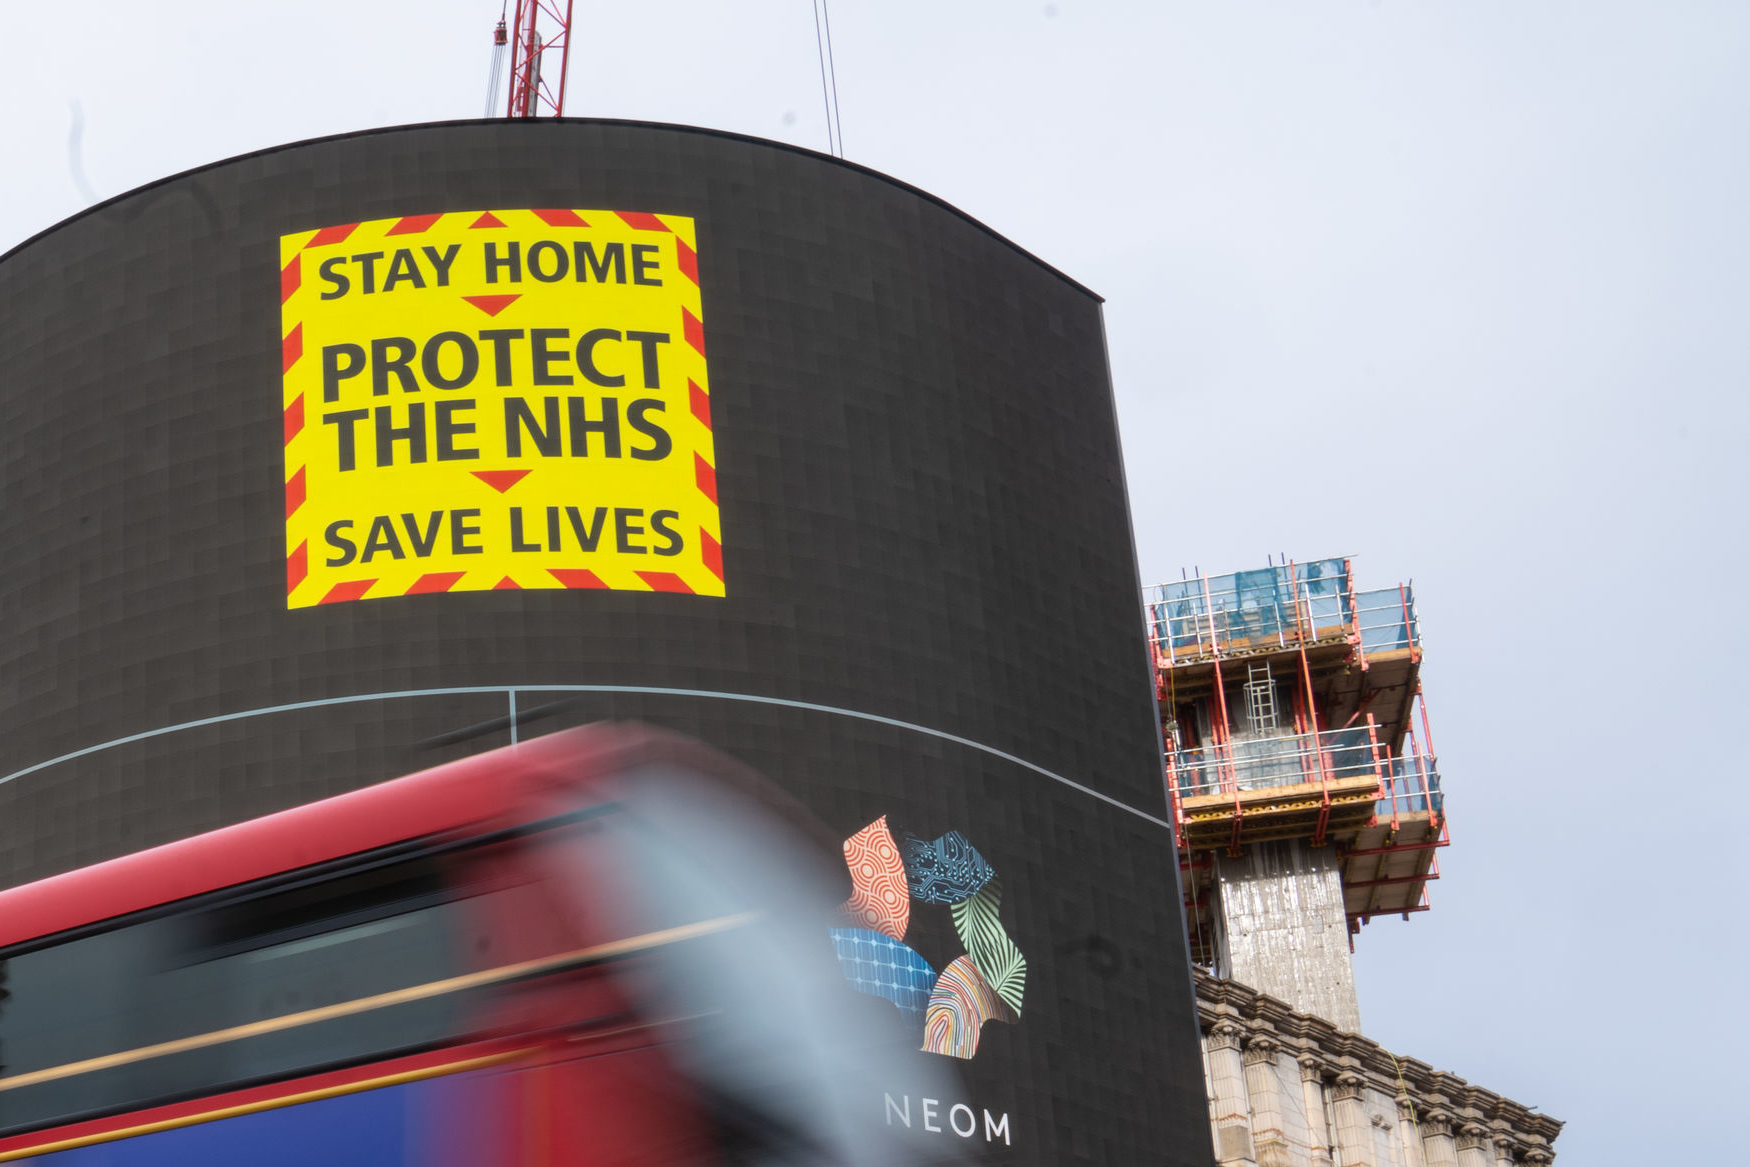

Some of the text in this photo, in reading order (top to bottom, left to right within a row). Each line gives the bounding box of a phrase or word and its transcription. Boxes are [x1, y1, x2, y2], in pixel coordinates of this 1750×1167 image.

[319, 240, 663, 300] STAY HOME
[321, 328, 670, 403] PROTECT
[323, 396, 673, 472] THE NHS
[324, 506, 684, 567] SAVE LIVES
[885, 1092, 1011, 1146] NEOM
